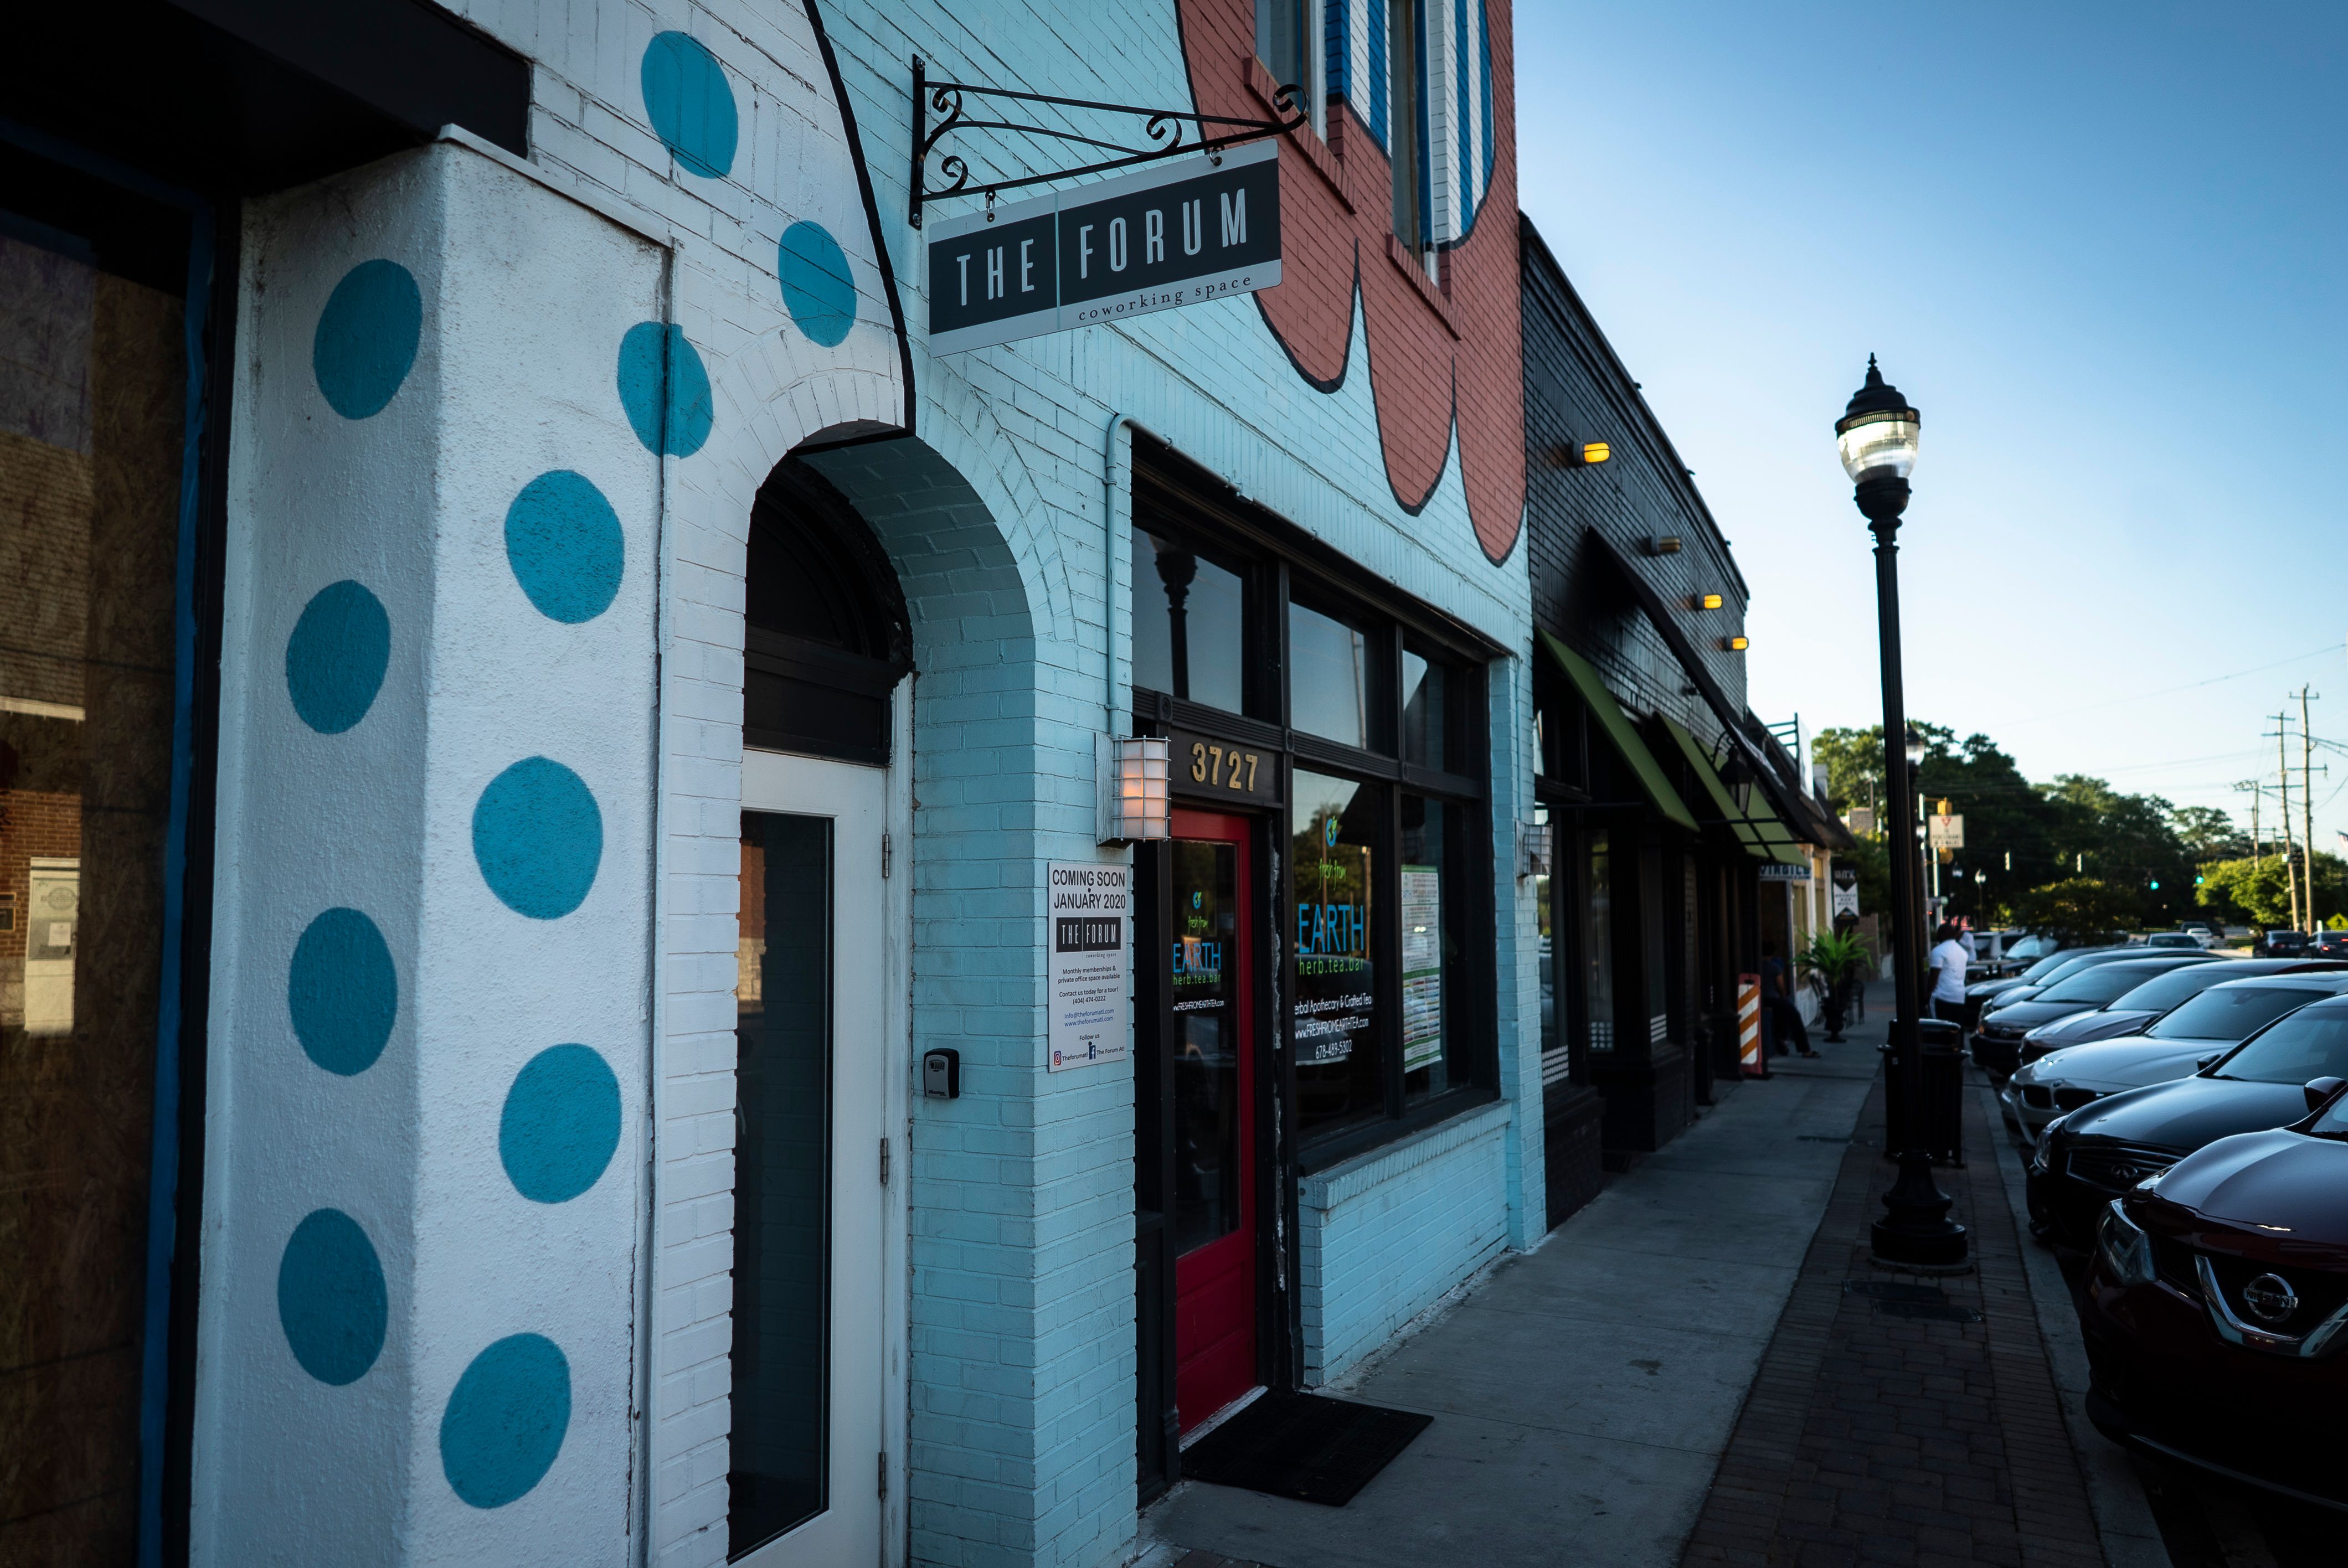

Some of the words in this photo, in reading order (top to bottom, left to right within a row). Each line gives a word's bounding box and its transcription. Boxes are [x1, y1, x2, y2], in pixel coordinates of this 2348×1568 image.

[957, 239, 1034, 306] THE
[1080, 188, 1247, 279] FORUM
[1079, 291, 1183, 321] coworking
[1195, 277, 1250, 298] space
[1193, 742, 1258, 792] 3727
[1052, 869, 1094, 886] COMING
[1097, 871, 1125, 887] SOON
[1054, 893, 1101, 909] JANUARY
[1104, 894, 1126, 909] 2020
[1062, 925, 1078, 944] THE
[1087, 924, 1116, 943] FORUM
[1299, 904, 1364, 953] EARTH
[1173, 942, 1221, 973] EARTH
[1299, 953, 1363, 975] herb.tea.bar
[1173, 973, 1221, 985] herb.tea.bar
[1295, 1000, 1309, 1015] erbal
[1310, 998, 1339, 1014] Apothecary
[1340, 996, 1344, 1008] &
[1345, 993, 1362, 1007] Crafted
[1064, 1016, 1114, 1027] www.theforumatl.com
[1062, 1052, 1088, 1061] Theforumatl
[2246, 1290, 2290, 1308] NISSAN
